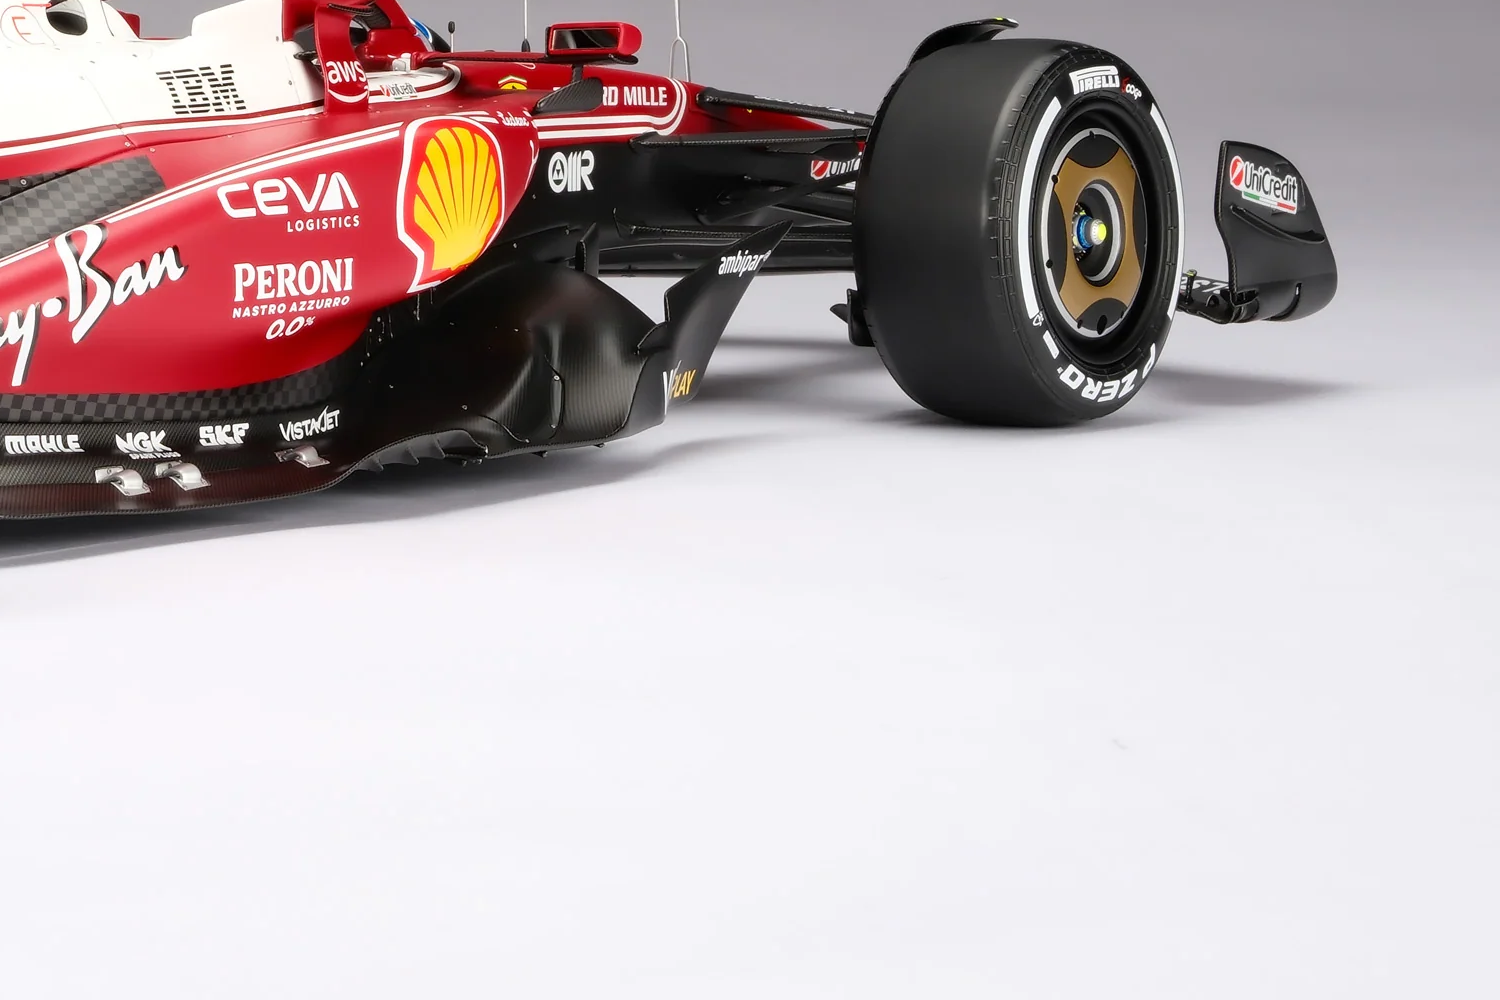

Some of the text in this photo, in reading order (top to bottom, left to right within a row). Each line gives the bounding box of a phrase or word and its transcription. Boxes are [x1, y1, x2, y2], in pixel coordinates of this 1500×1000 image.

[326, 60, 367, 84] aws
[1069, 66, 1120, 95] PIRELLI
[156, 64, 246, 114] IBM
[623, 86, 668, 106] MILLE
[1243, 162, 1297, 204] UniCredit
[287, 215, 360, 233] LOGISTICS
[718, 249, 765, 278] ambipar
[233, 257, 354, 302] PERONI
[232, 295, 350, 319] NASTRO AZZURRO
[1060, 364, 1138, 402] ZERO
[4, 434, 86, 455] MAHLE
[115, 430, 172, 454] NGK
[199, 423, 249, 446] SKF
